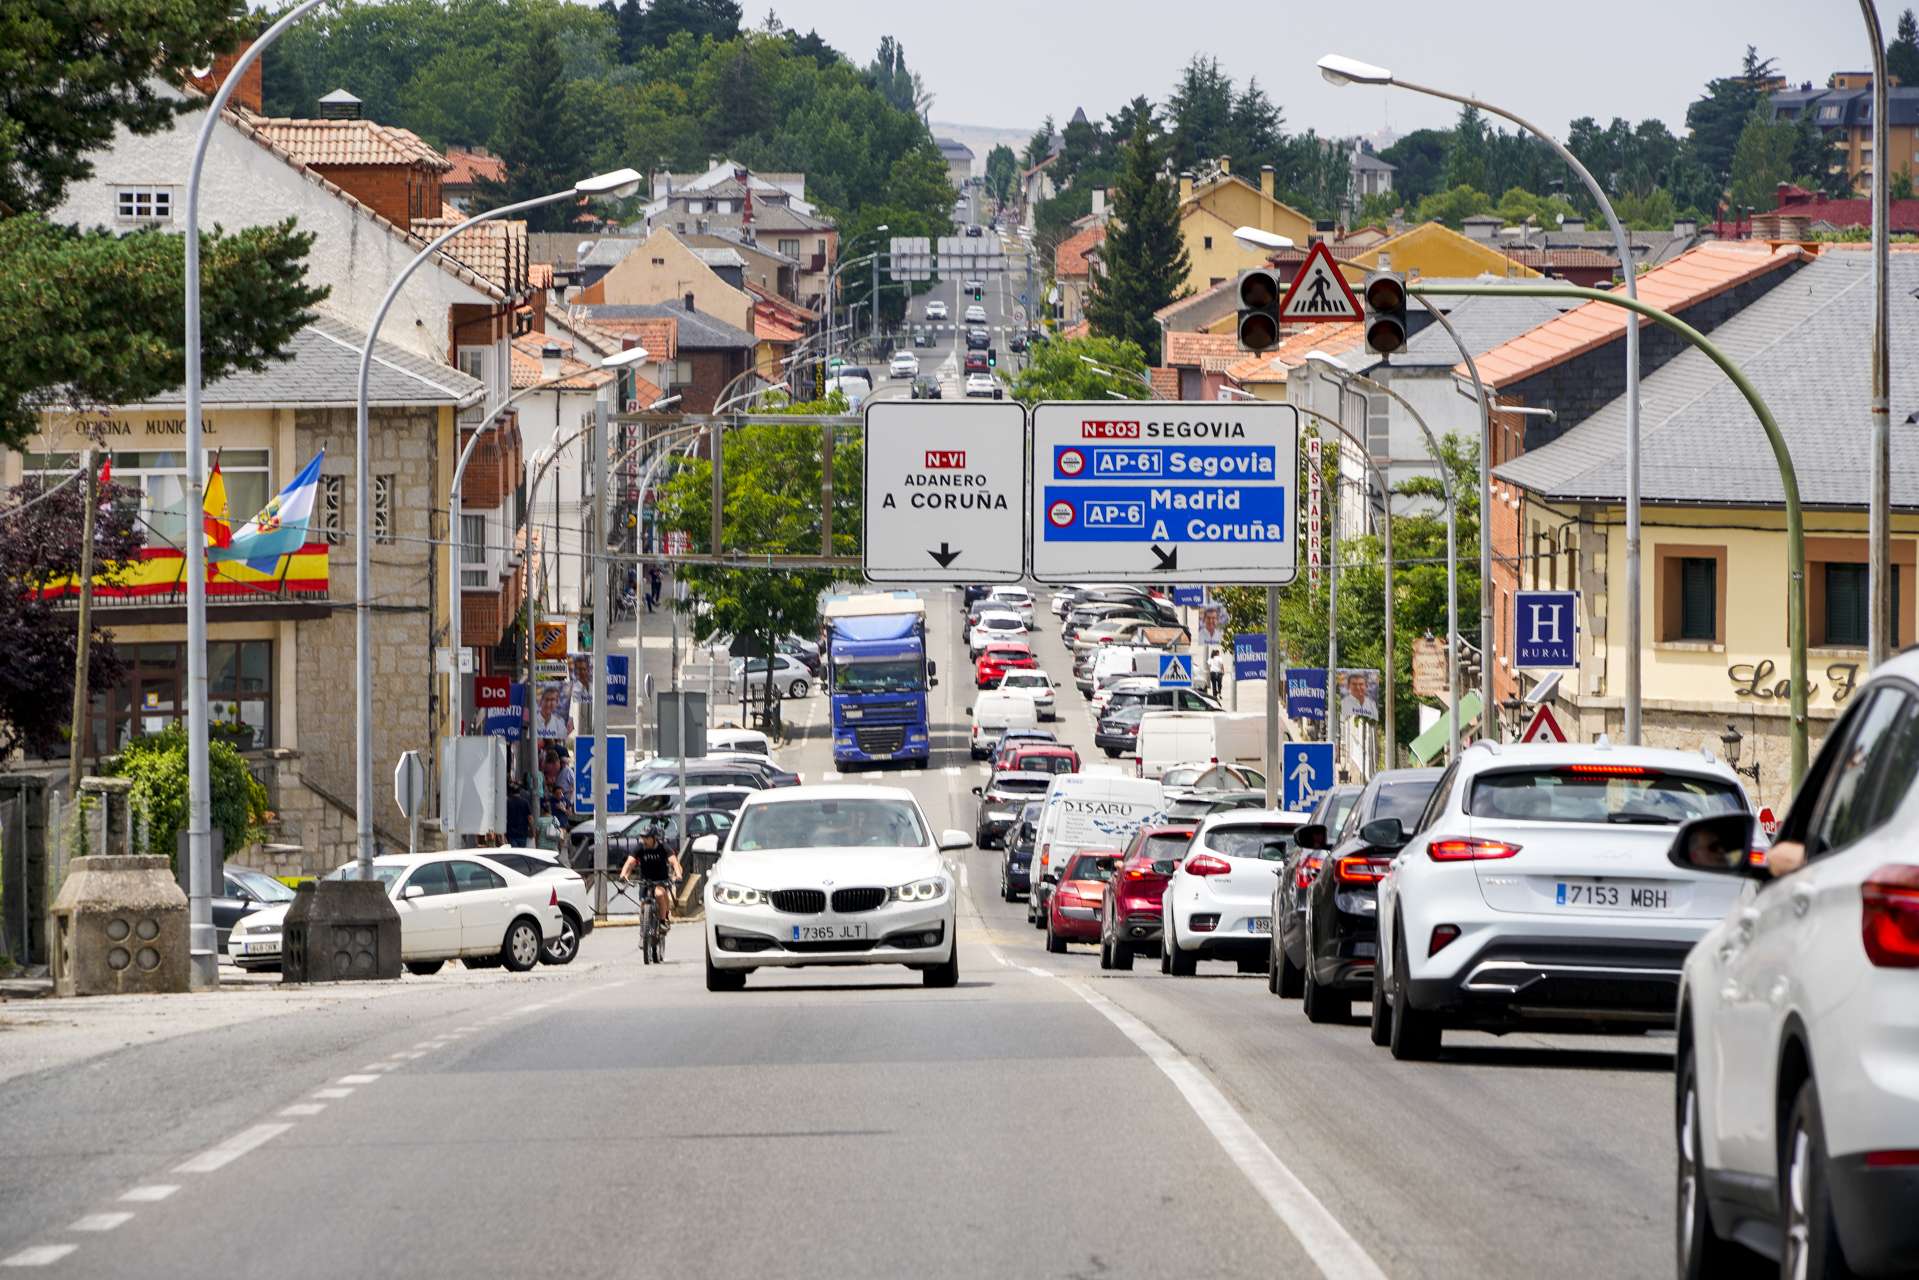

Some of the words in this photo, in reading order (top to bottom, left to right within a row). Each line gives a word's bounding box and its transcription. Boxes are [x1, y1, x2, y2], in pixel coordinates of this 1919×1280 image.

[145, 419, 217, 435] MUNICAL
[1083, 422, 1139, 437] N-603
[1146, 422, 1246, 438] SEGOVIA
[927, 452, 964, 467] N-VI
[1099, 453, 1160, 472] AP-61
[1168, 451, 1273, 476] Segovia
[904, 474, 987, 487] ADANERO
[882, 492, 897, 509] A
[910, 489, 1008, 510] CORUÑA
[1150, 488, 1241, 510] Madrid
[1089, 506, 1140, 523] AP-6
[1151, 519, 1170, 541] A
[1186, 518, 1281, 541] Coruña
[1528, 604, 1564, 643] H
[1522, 647, 1569, 658] RURAL
[1288, 686, 1326, 700] MOMENTO
[1571, 885, 1619, 905] 7153
[1630, 888, 1668, 909] MBH
[803, 926, 834, 939] 7365
[839, 925, 862, 938] JLT
